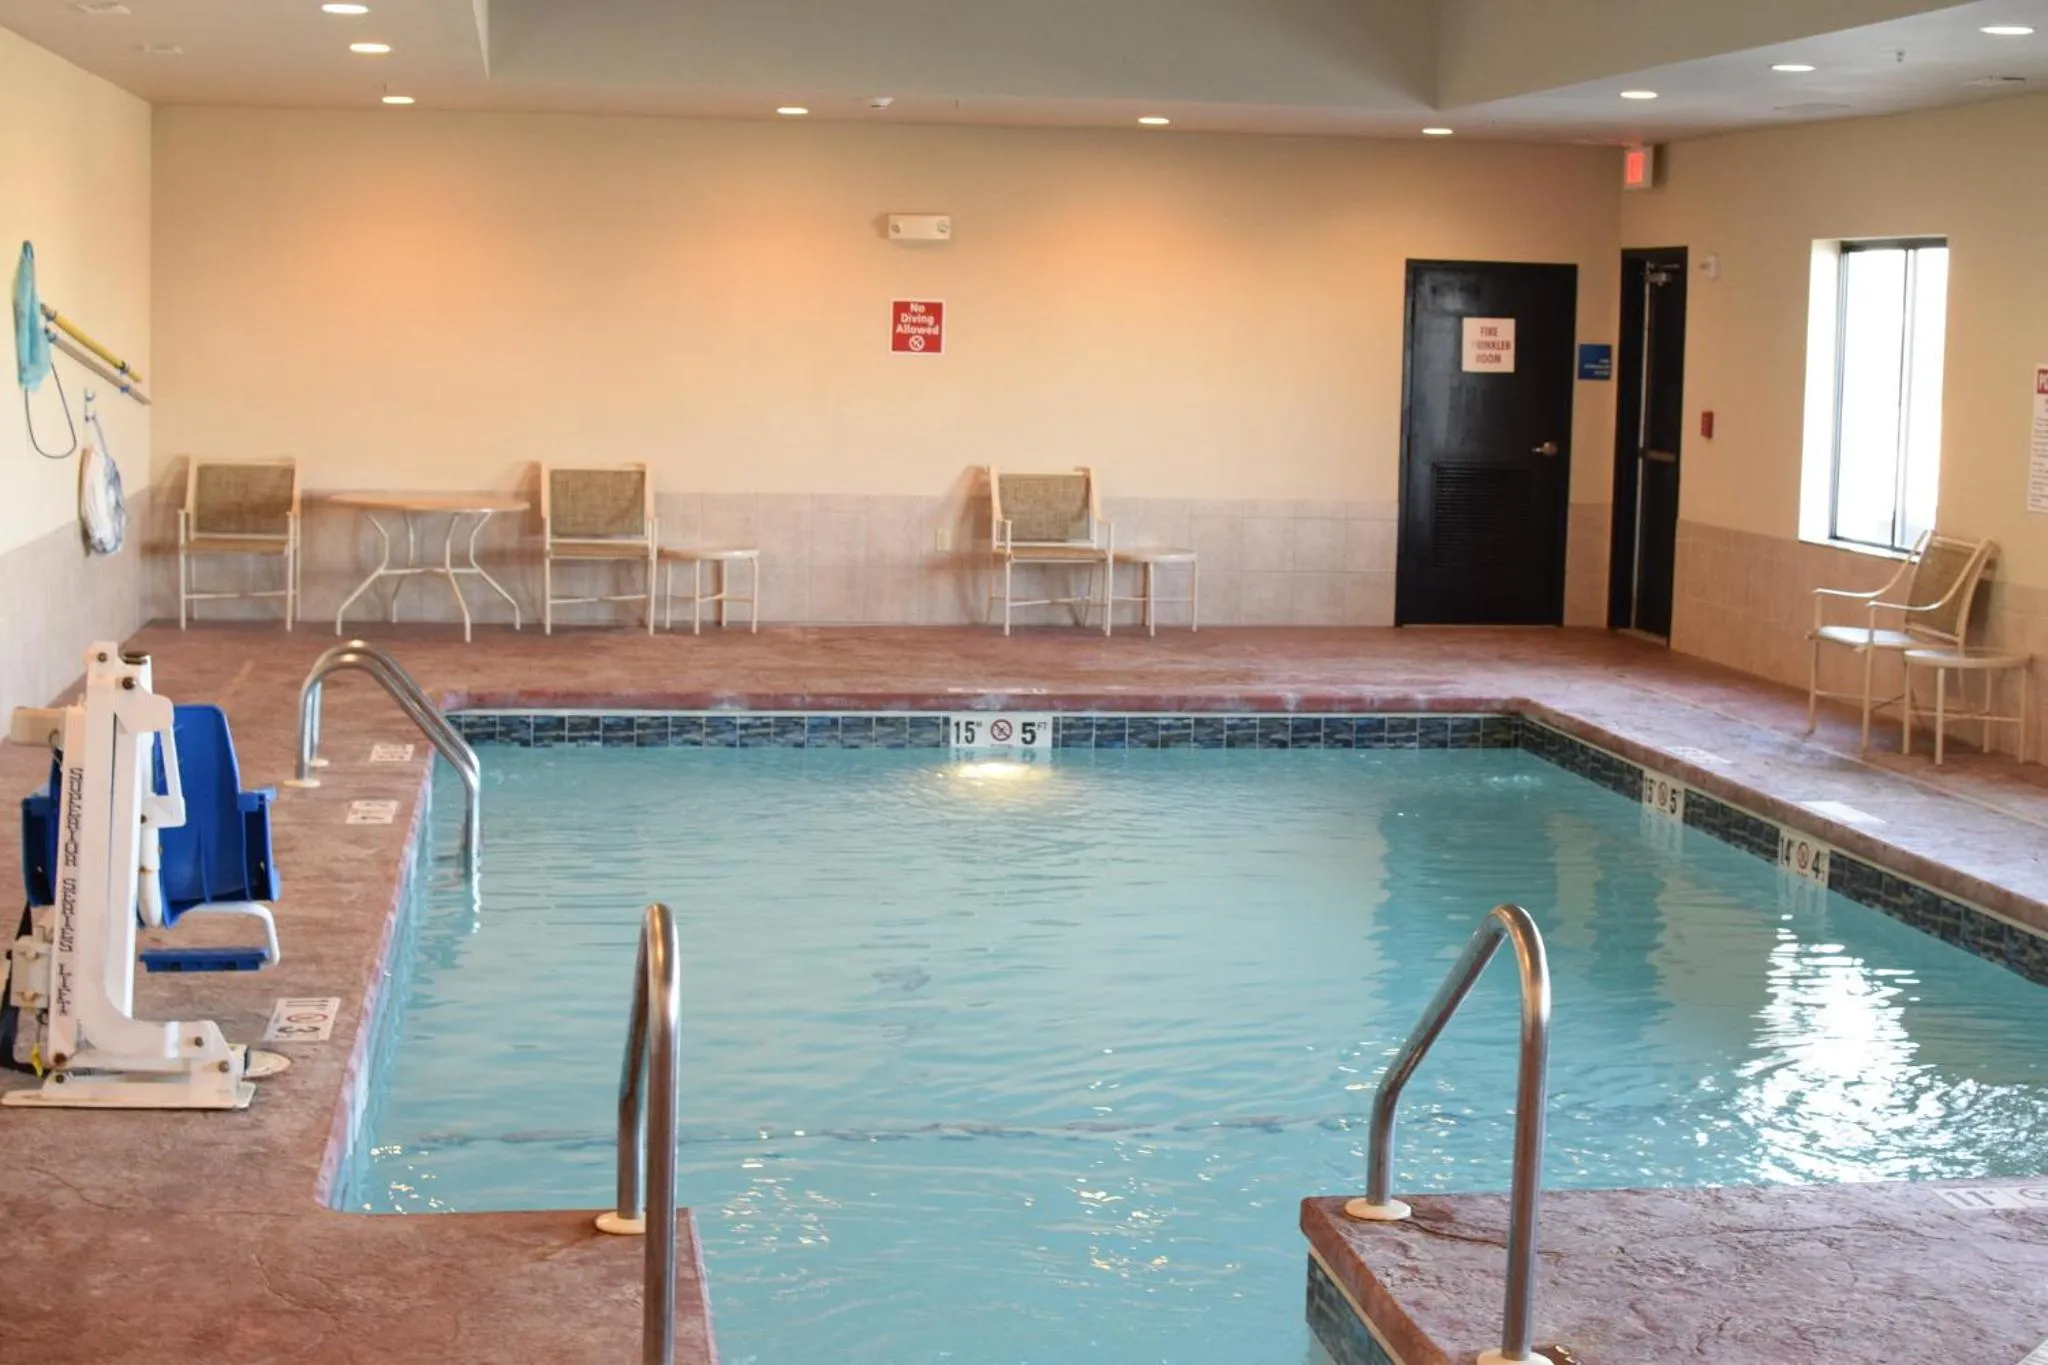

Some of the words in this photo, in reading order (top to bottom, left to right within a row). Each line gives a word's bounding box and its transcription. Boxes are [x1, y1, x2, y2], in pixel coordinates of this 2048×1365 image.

[910, 303, 926, 313] No
[900, 313, 935, 326] Diving
[896, 323, 939, 336] Allowed
